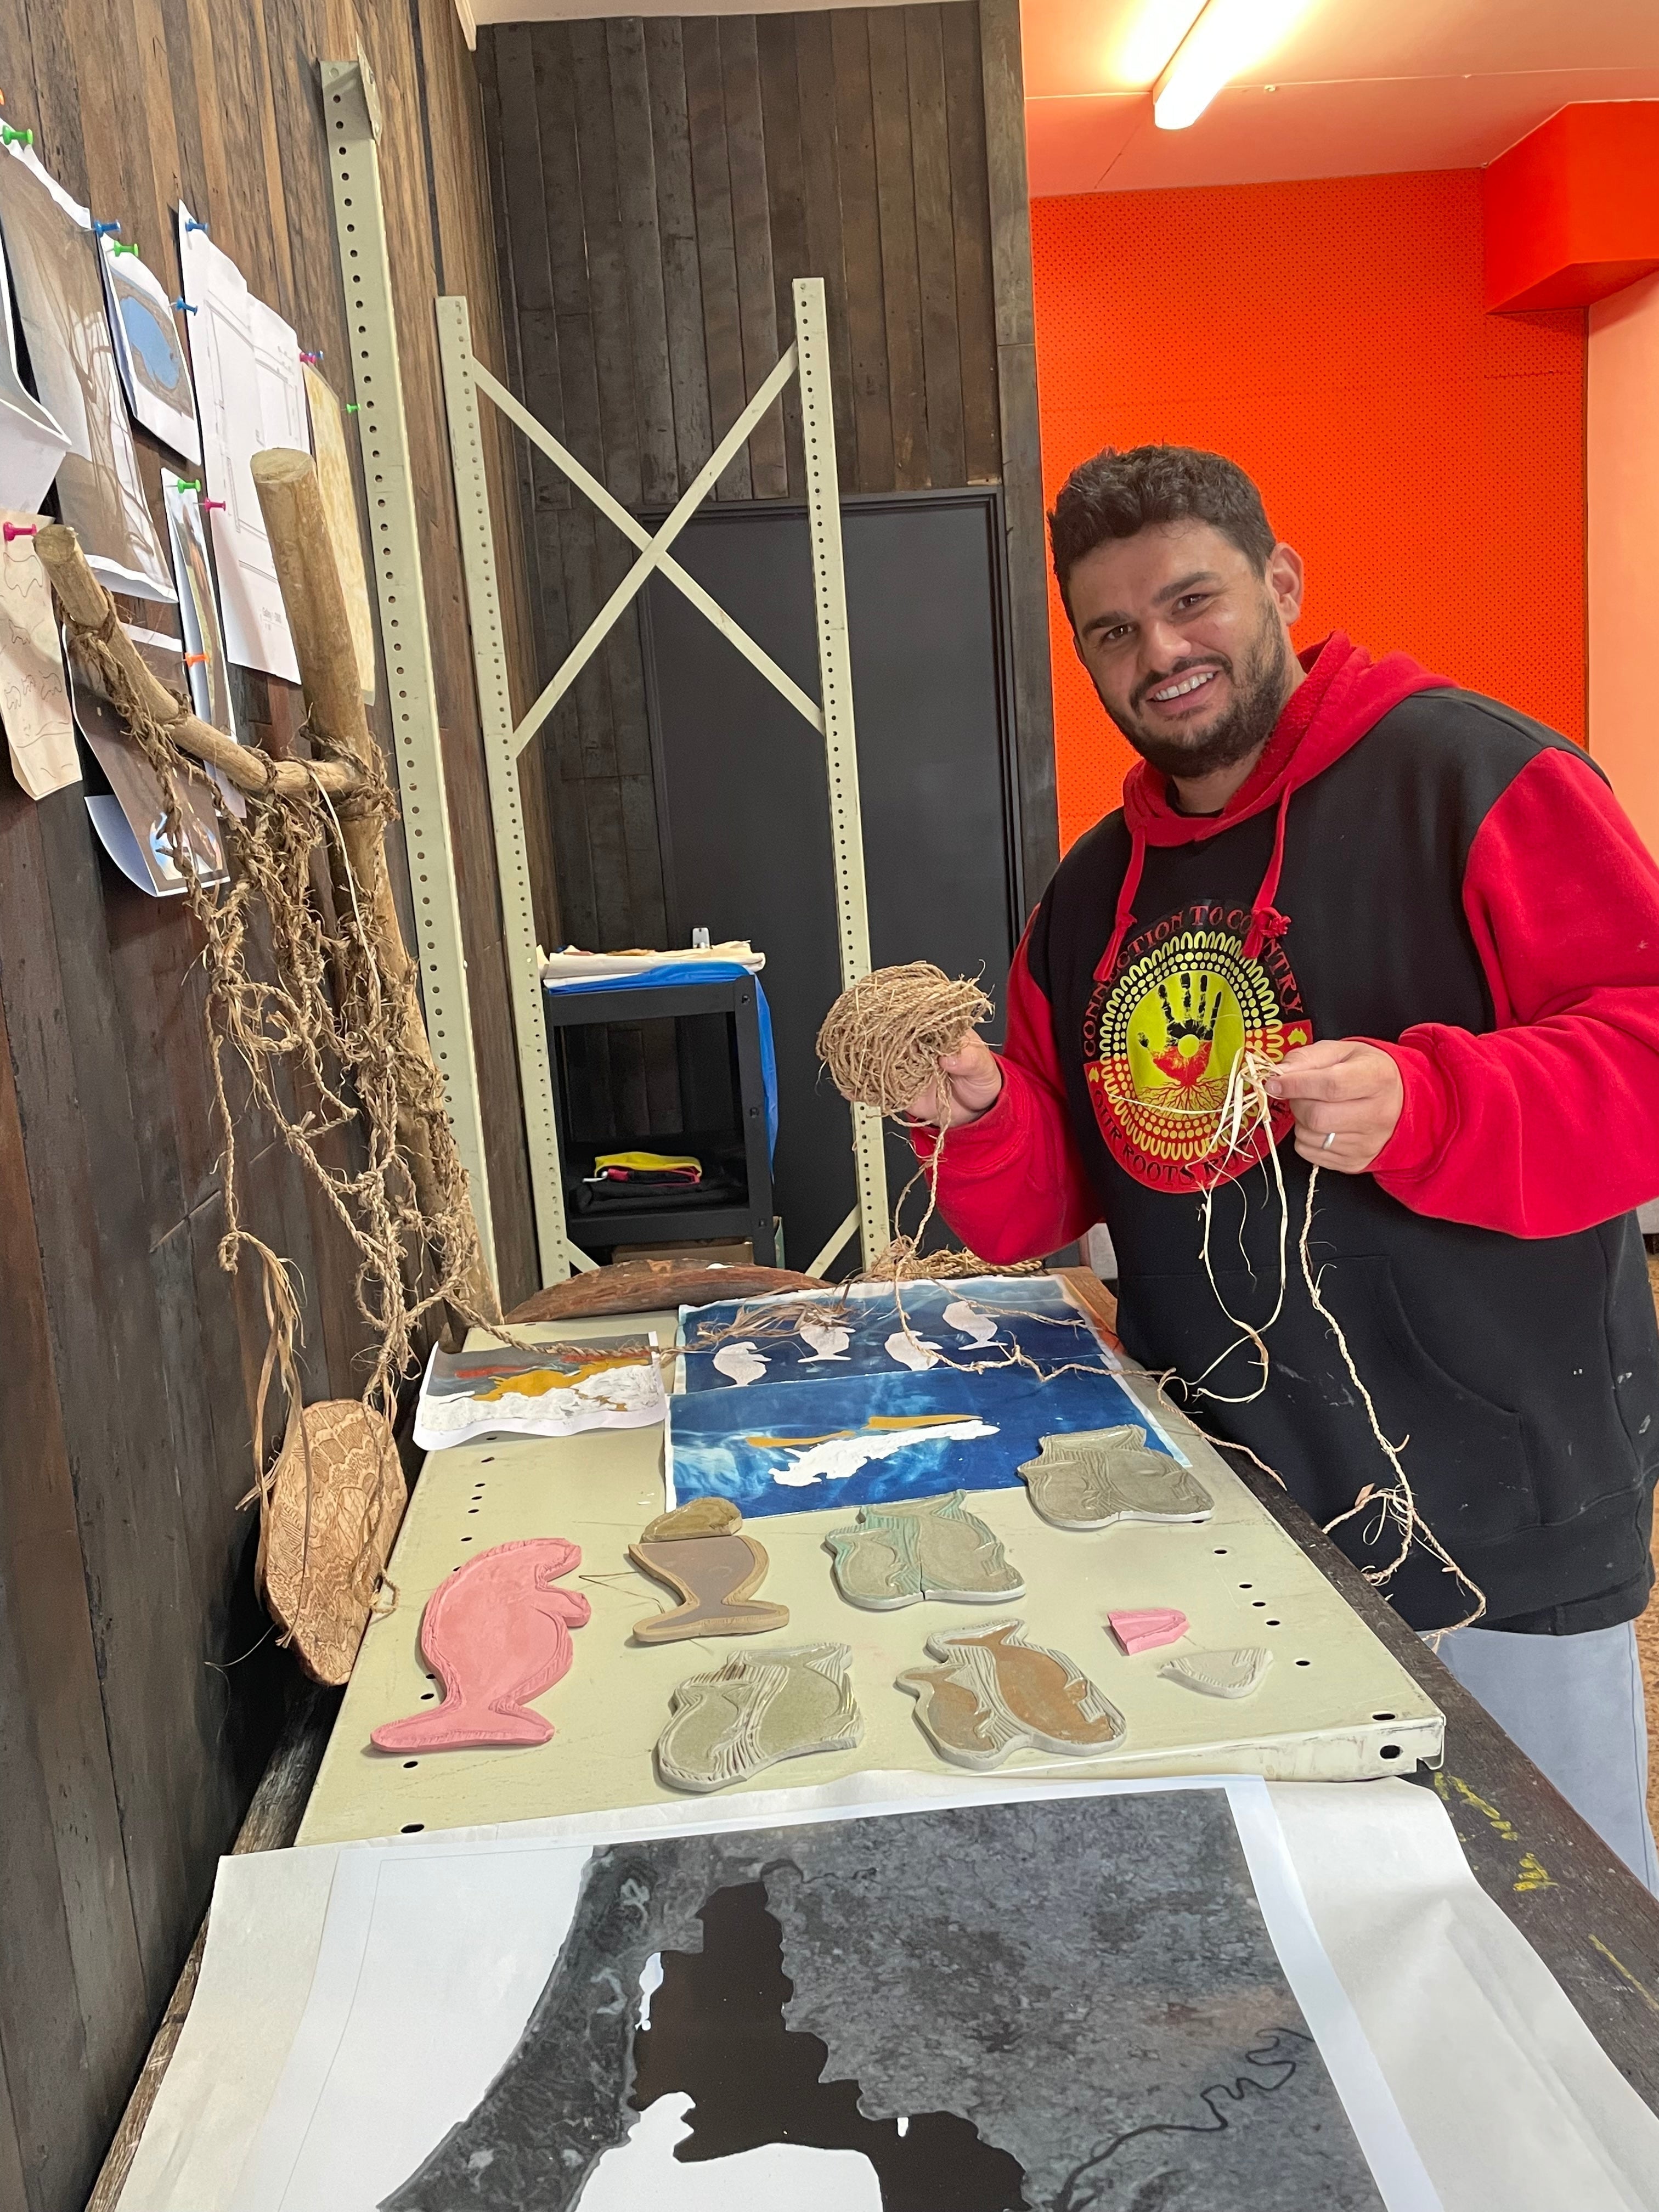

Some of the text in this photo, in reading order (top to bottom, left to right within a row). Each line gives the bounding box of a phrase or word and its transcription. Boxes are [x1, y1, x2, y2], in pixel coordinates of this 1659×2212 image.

[1189, 906, 1223, 927] TO
[1227, 909, 1304, 1015] CONTRY
[1094, 1089, 1123, 1144] OUR
[1123, 1141, 1196, 1186] ROOTS
